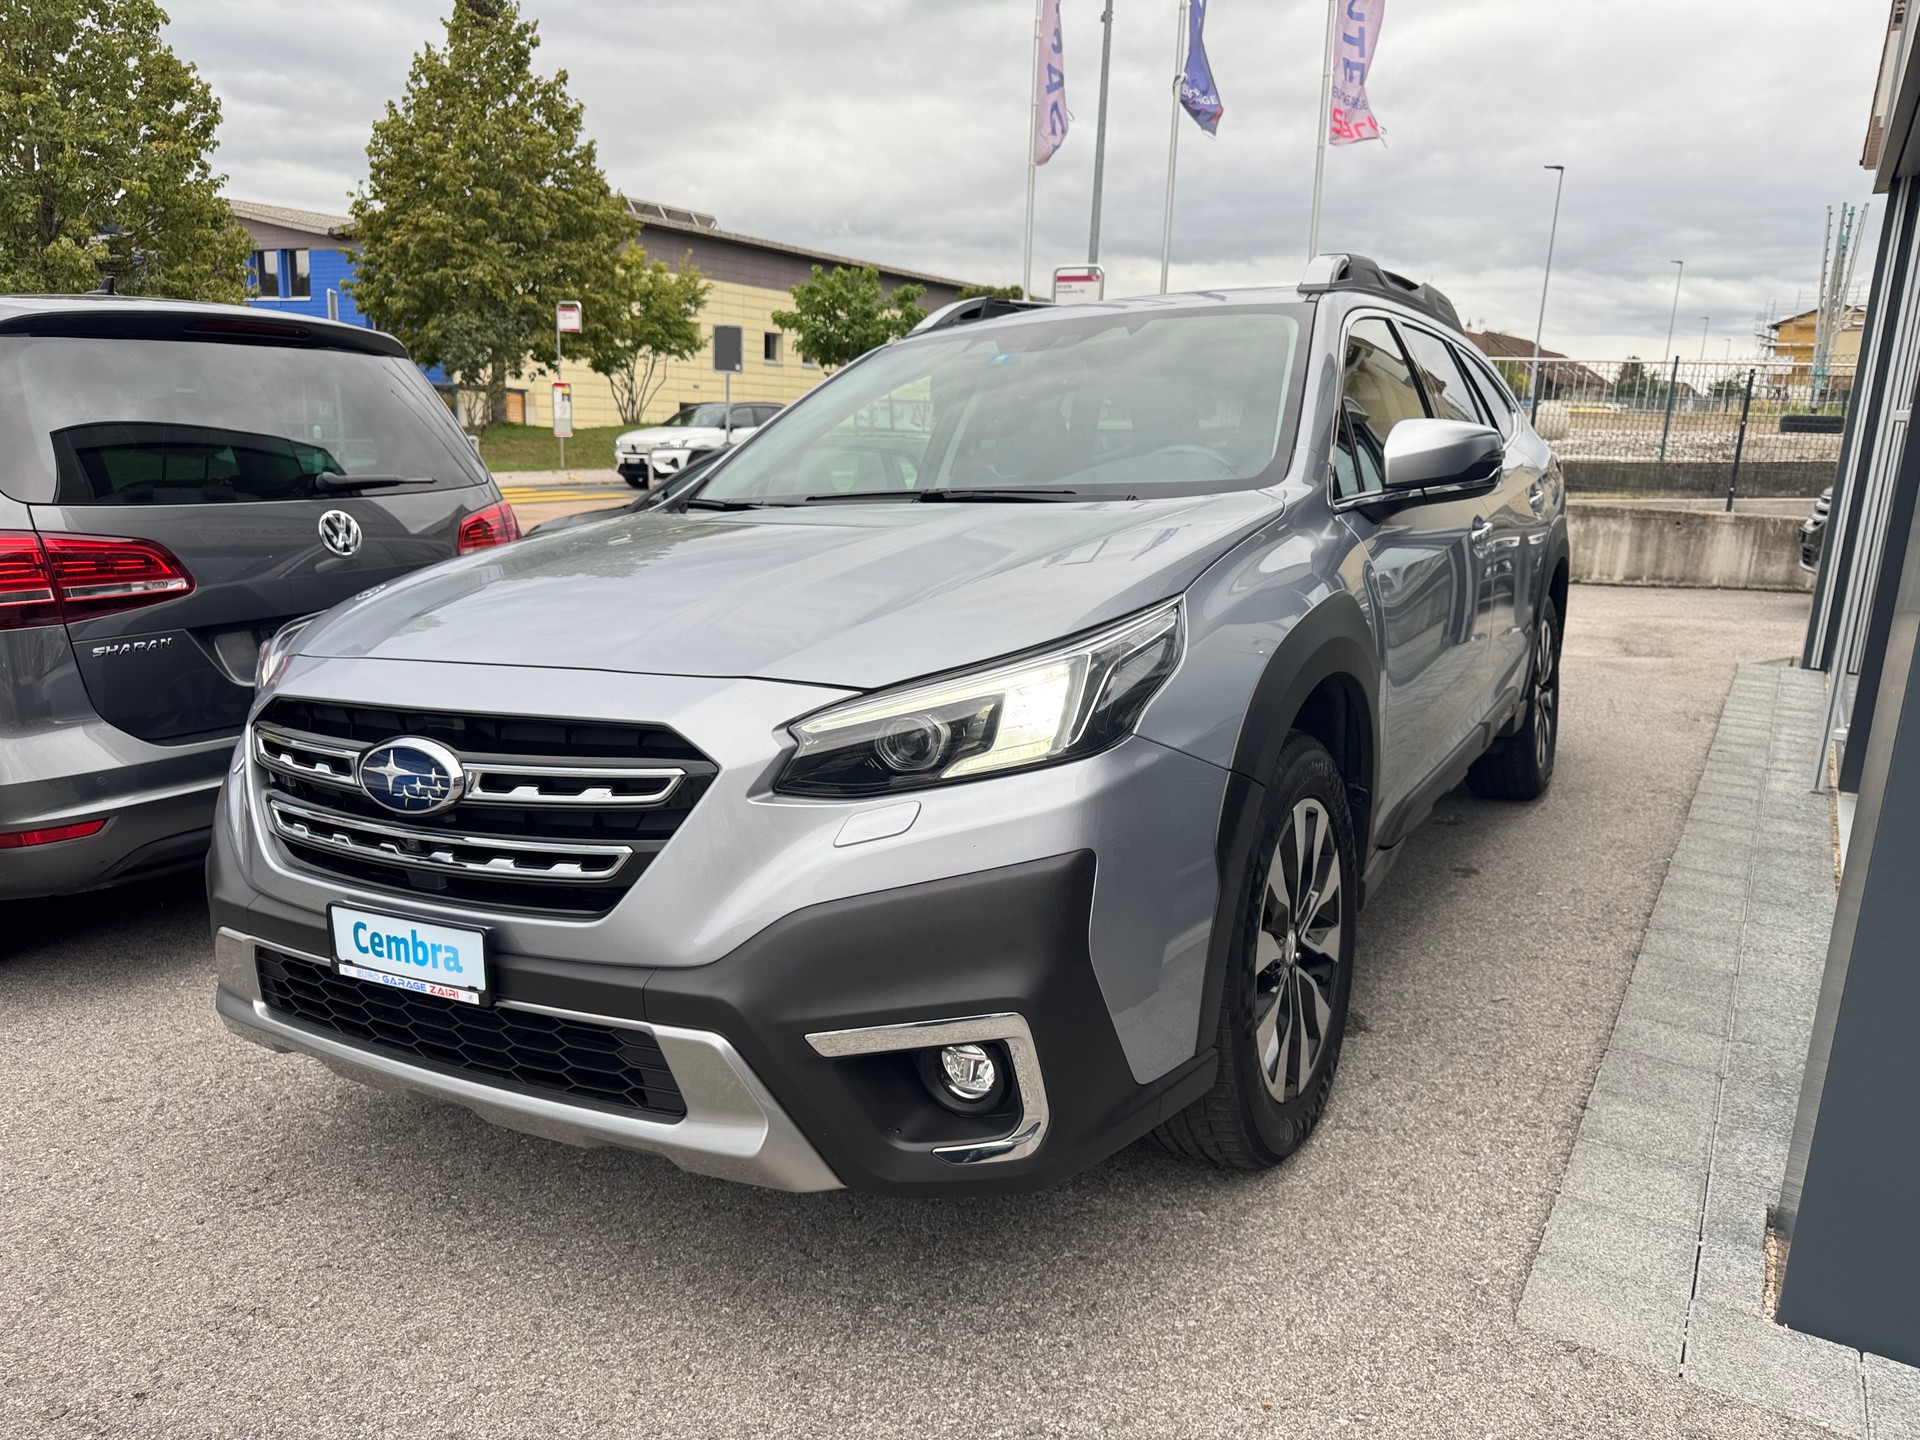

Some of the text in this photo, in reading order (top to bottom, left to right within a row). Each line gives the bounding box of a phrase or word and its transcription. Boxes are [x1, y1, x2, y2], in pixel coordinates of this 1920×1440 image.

[92, 637, 173, 658] SHARAN
[353, 921, 463, 974] Cembra
[355, 969, 459, 999] EURO GARAGE ZAIRI
